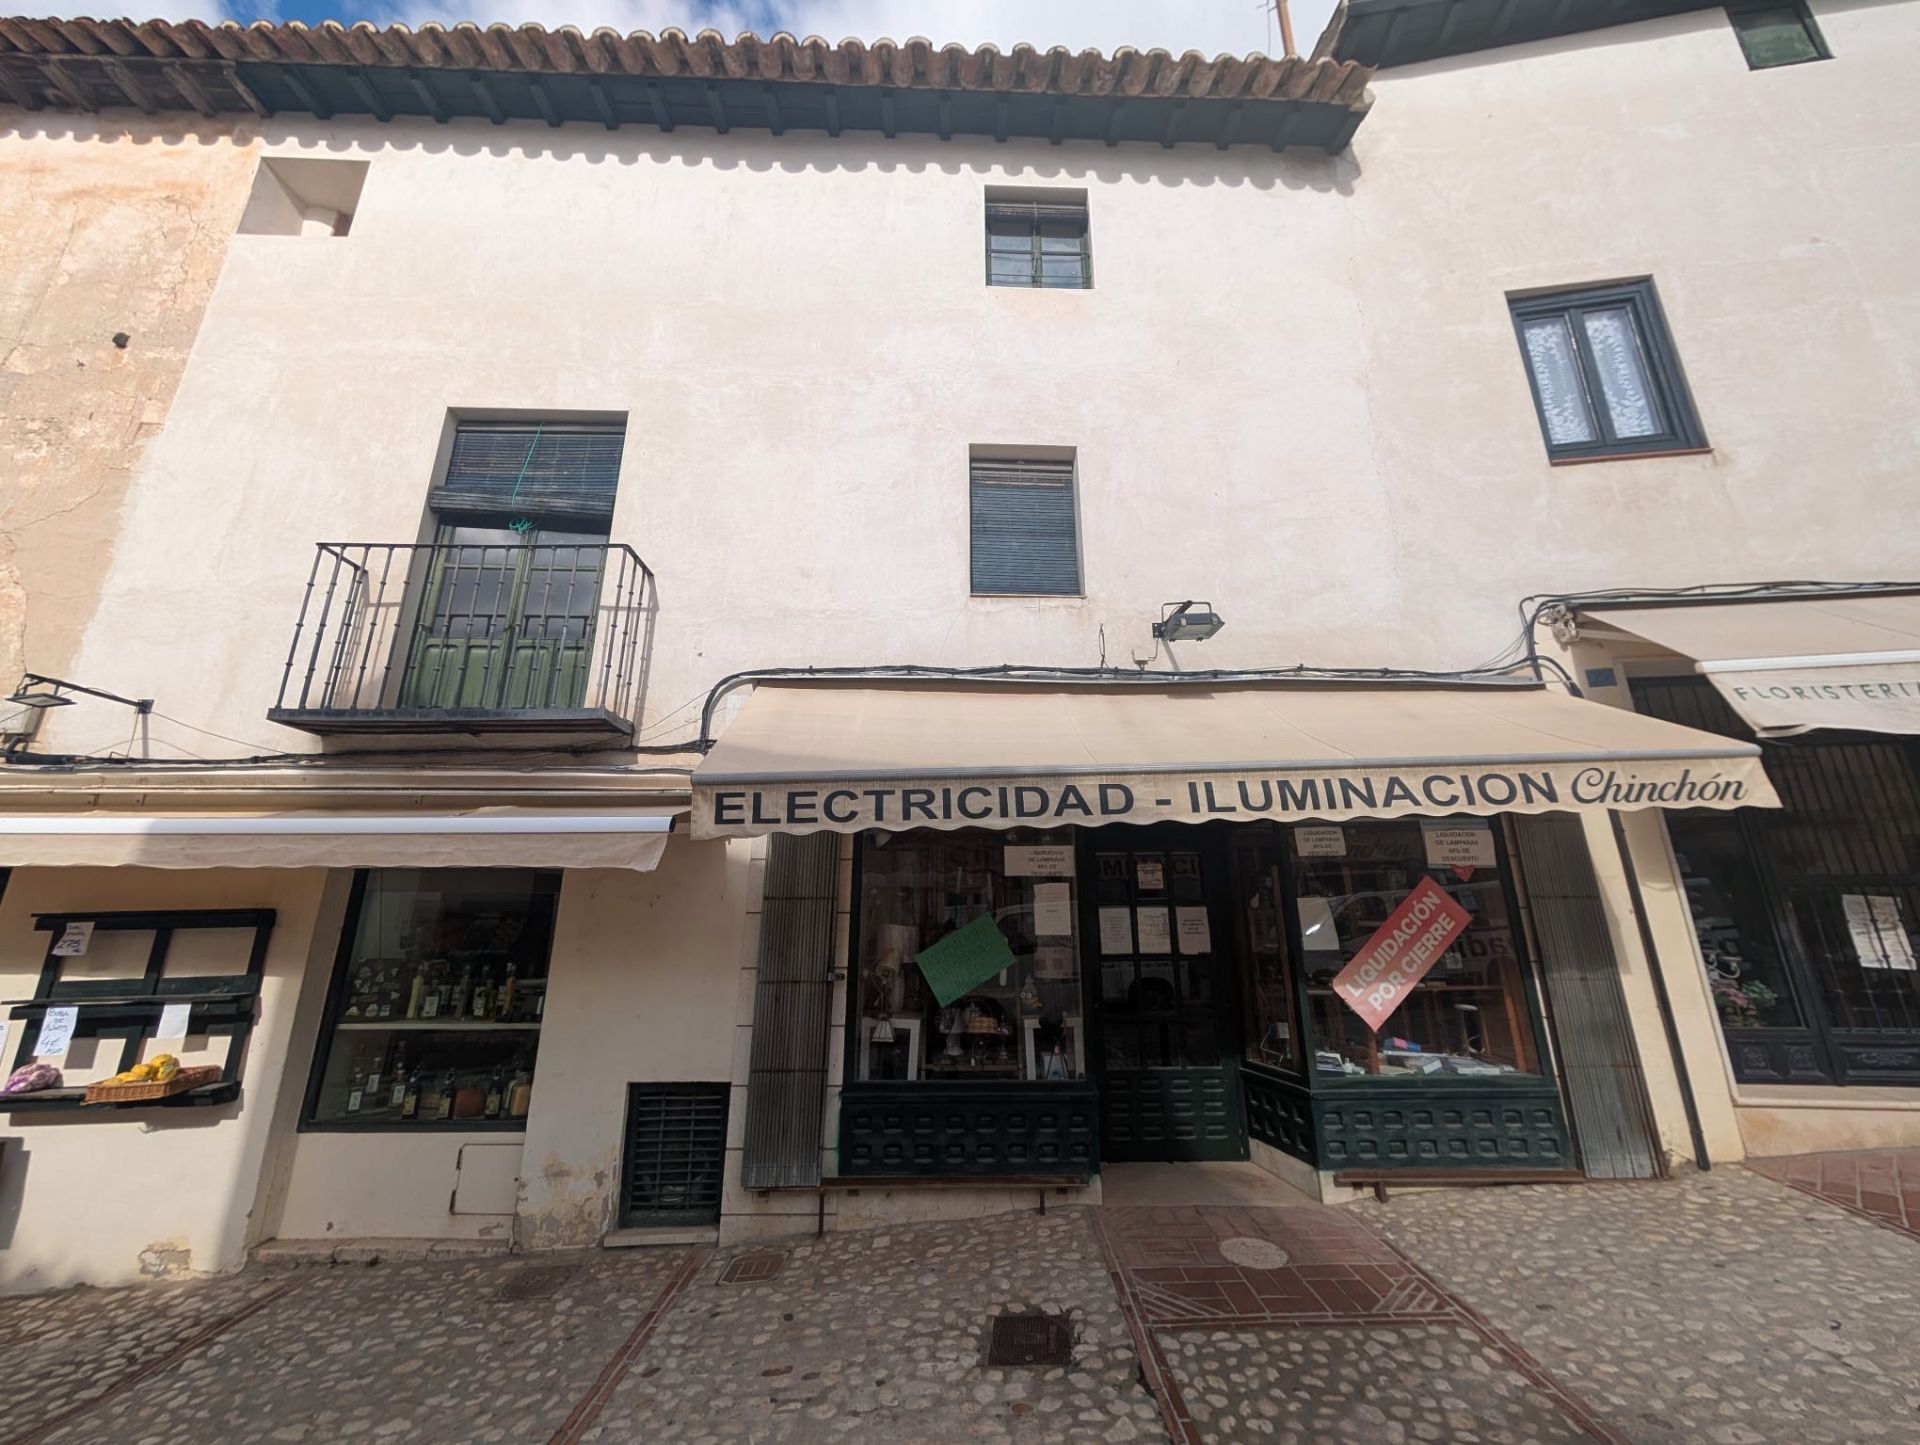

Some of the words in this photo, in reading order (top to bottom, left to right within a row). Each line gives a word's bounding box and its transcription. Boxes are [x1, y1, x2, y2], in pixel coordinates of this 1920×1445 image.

[1733, 681, 1920, 701] FLORISTERI
[714, 784, 1134, 826] ELECTRICIDAD
[1188, 771, 1559, 814] ILUMINACION
[1571, 767, 1748, 804] Chinchón
[1346, 890, 1441, 998] LIQUIDACIÓN
[1368, 970, 1406, 1011] POR
[1402, 913, 1456, 974] CIERRE
